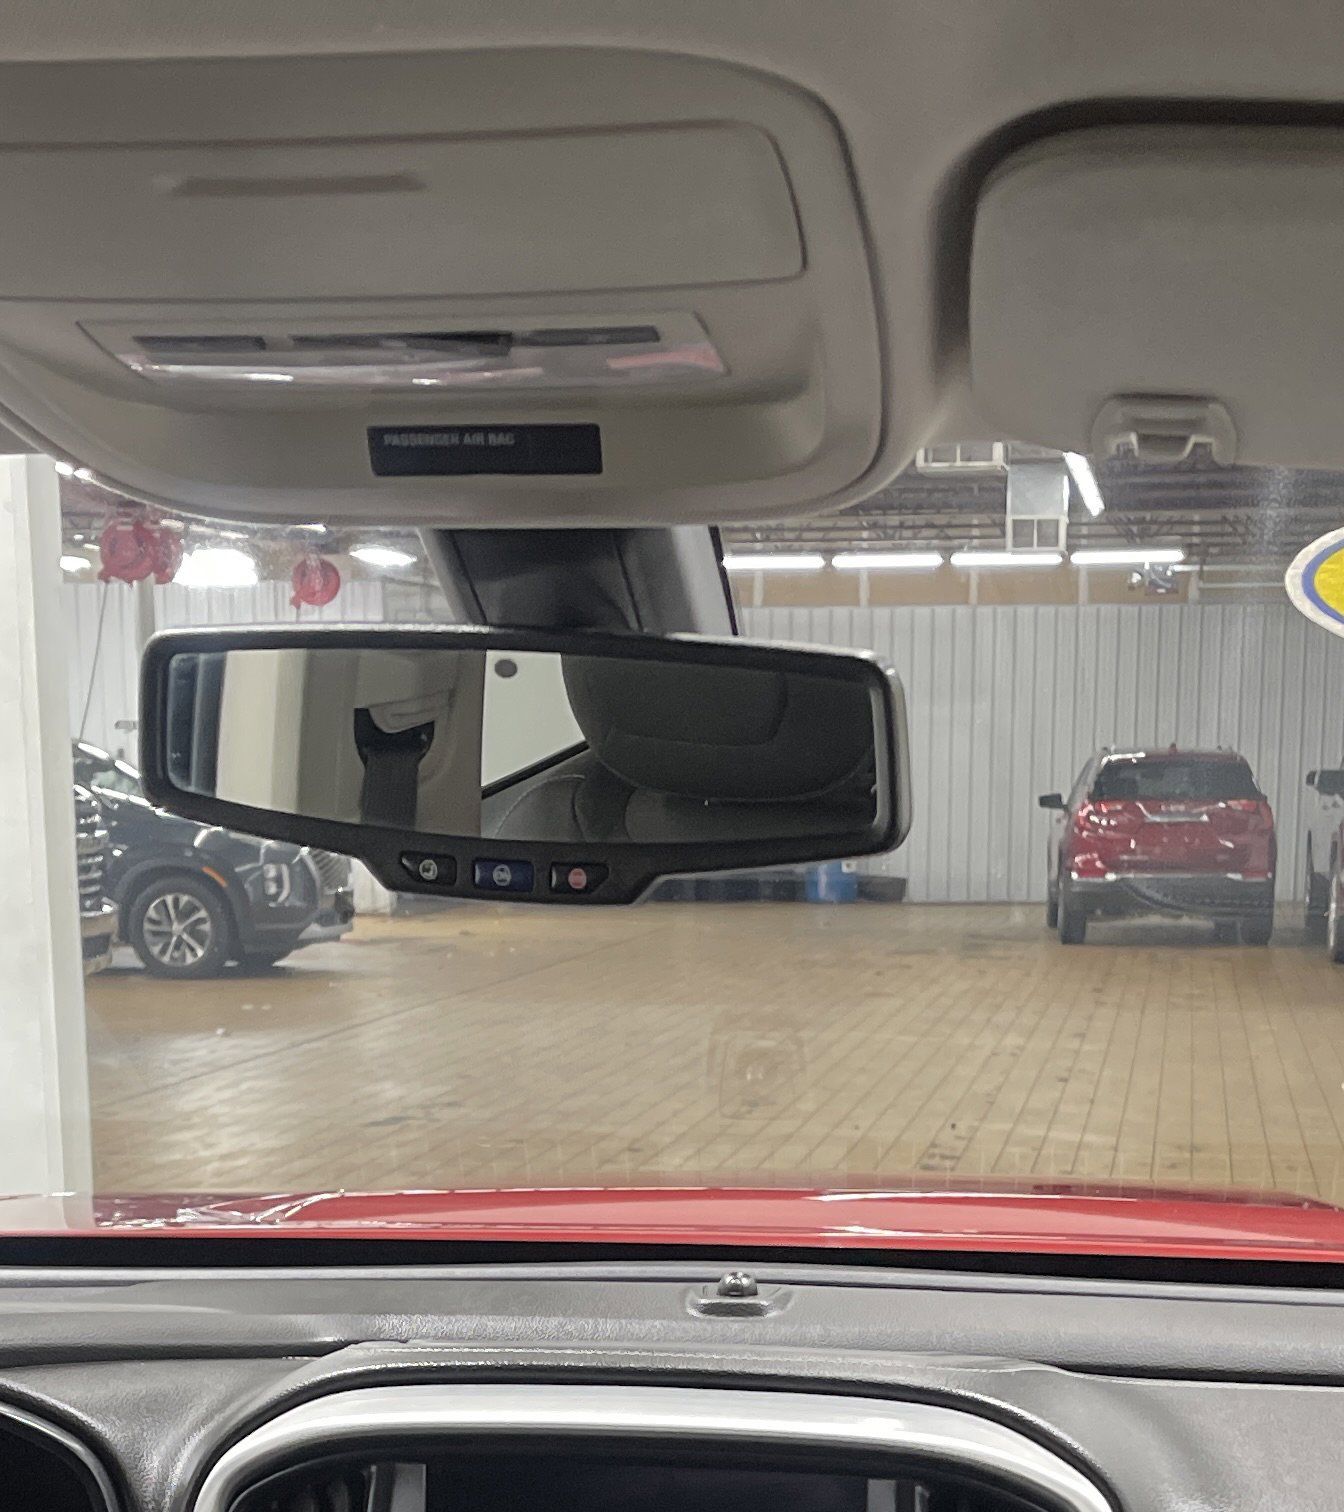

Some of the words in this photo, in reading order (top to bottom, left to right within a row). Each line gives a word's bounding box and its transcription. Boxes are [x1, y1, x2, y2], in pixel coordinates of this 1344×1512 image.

[383, 432, 460, 447] PASSENGER
[463, 431, 485, 446] AIR
[488, 432, 516, 447] BAG
